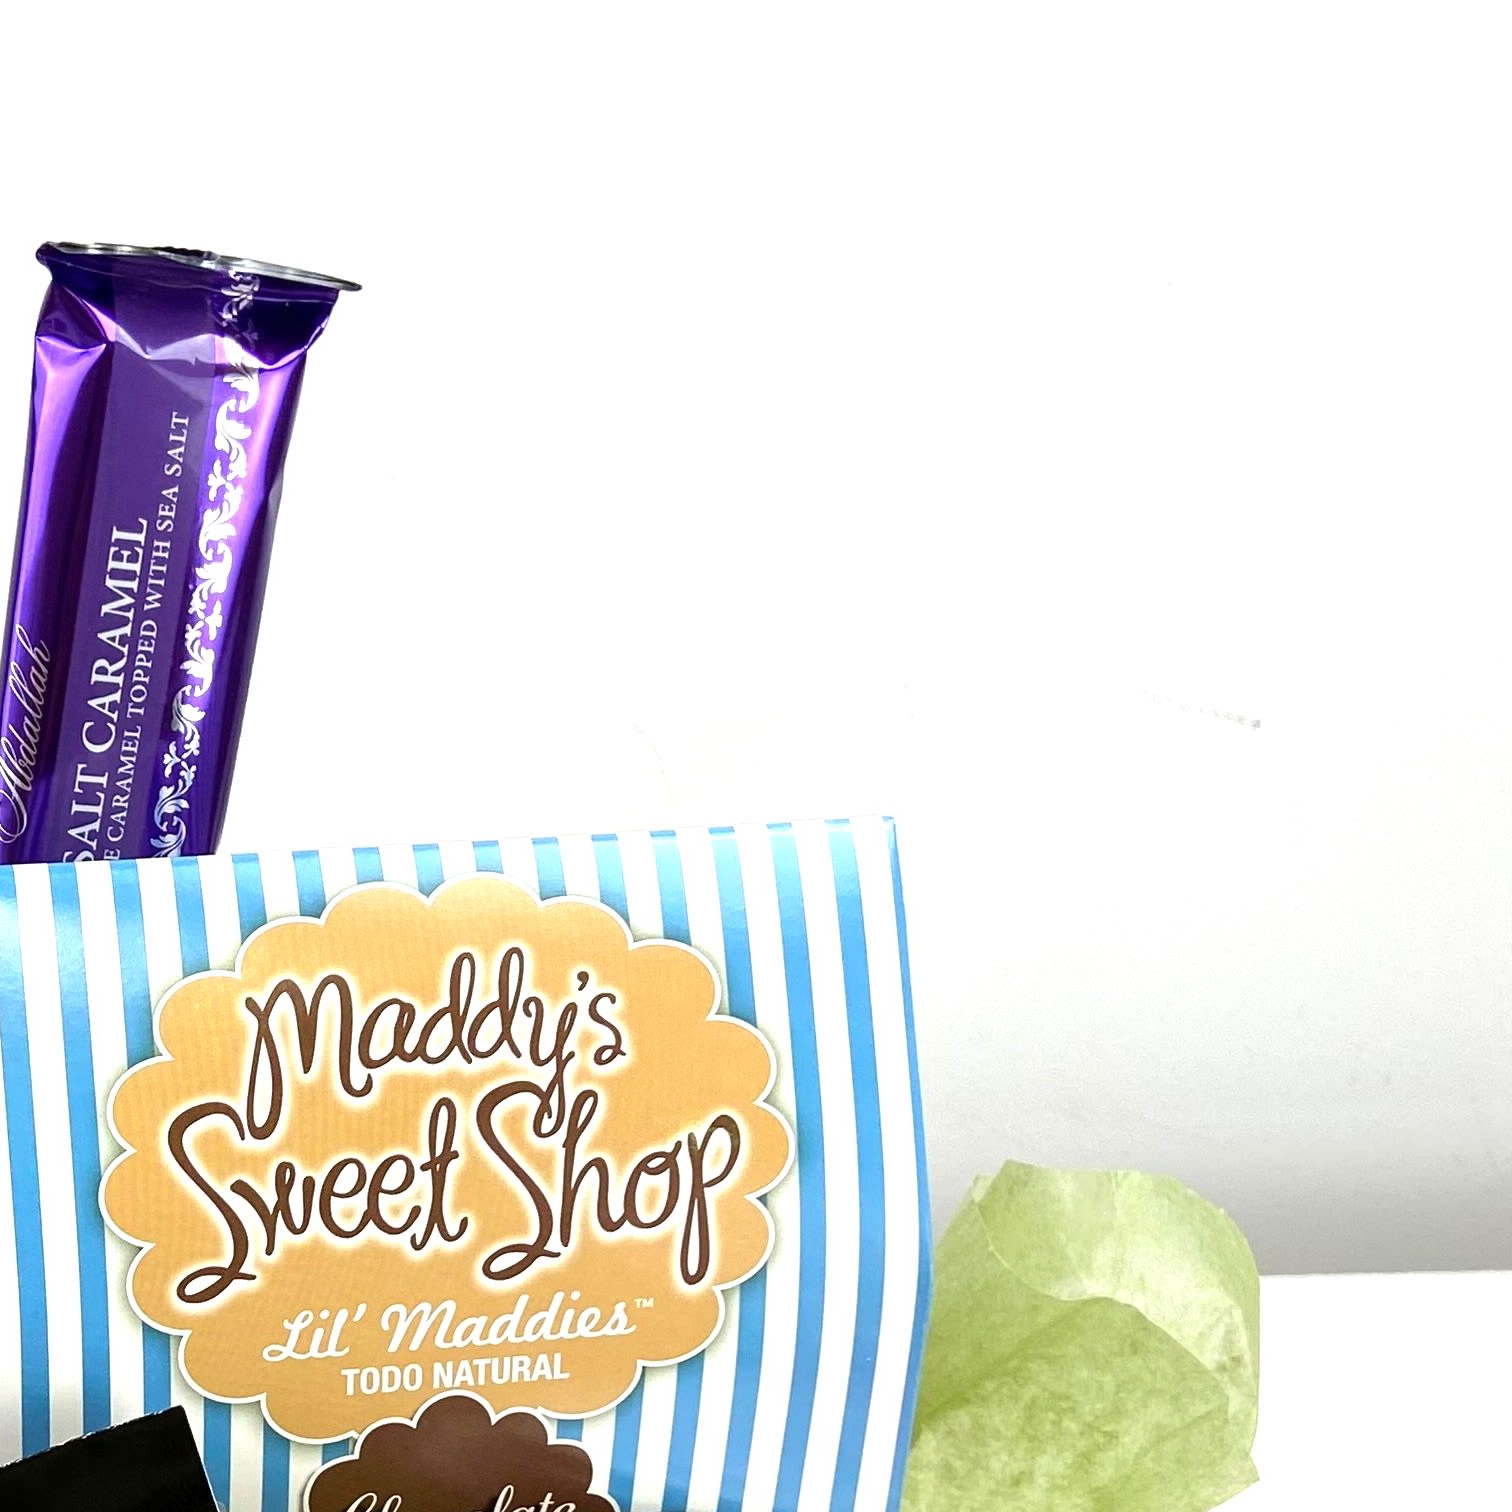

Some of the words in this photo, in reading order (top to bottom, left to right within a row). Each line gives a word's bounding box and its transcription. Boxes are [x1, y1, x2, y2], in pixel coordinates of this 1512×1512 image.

[163, 412, 190, 477] SALT
[156, 484, 180, 533] SEA
[144, 539, 171, 616] WITH
[81, 517, 148, 753] CARAMEL
[126, 619, 159, 717] TOPPED
[107, 726, 144, 842] CARAMEL
[245, 946, 626, 1140] Maddy's
[168, 1096, 469, 1303] Sweet
[476, 1081, 741, 1286] Shop
[341, 1364, 424, 1397] TODO
[431, 1352, 571, 1390] NATURAL
